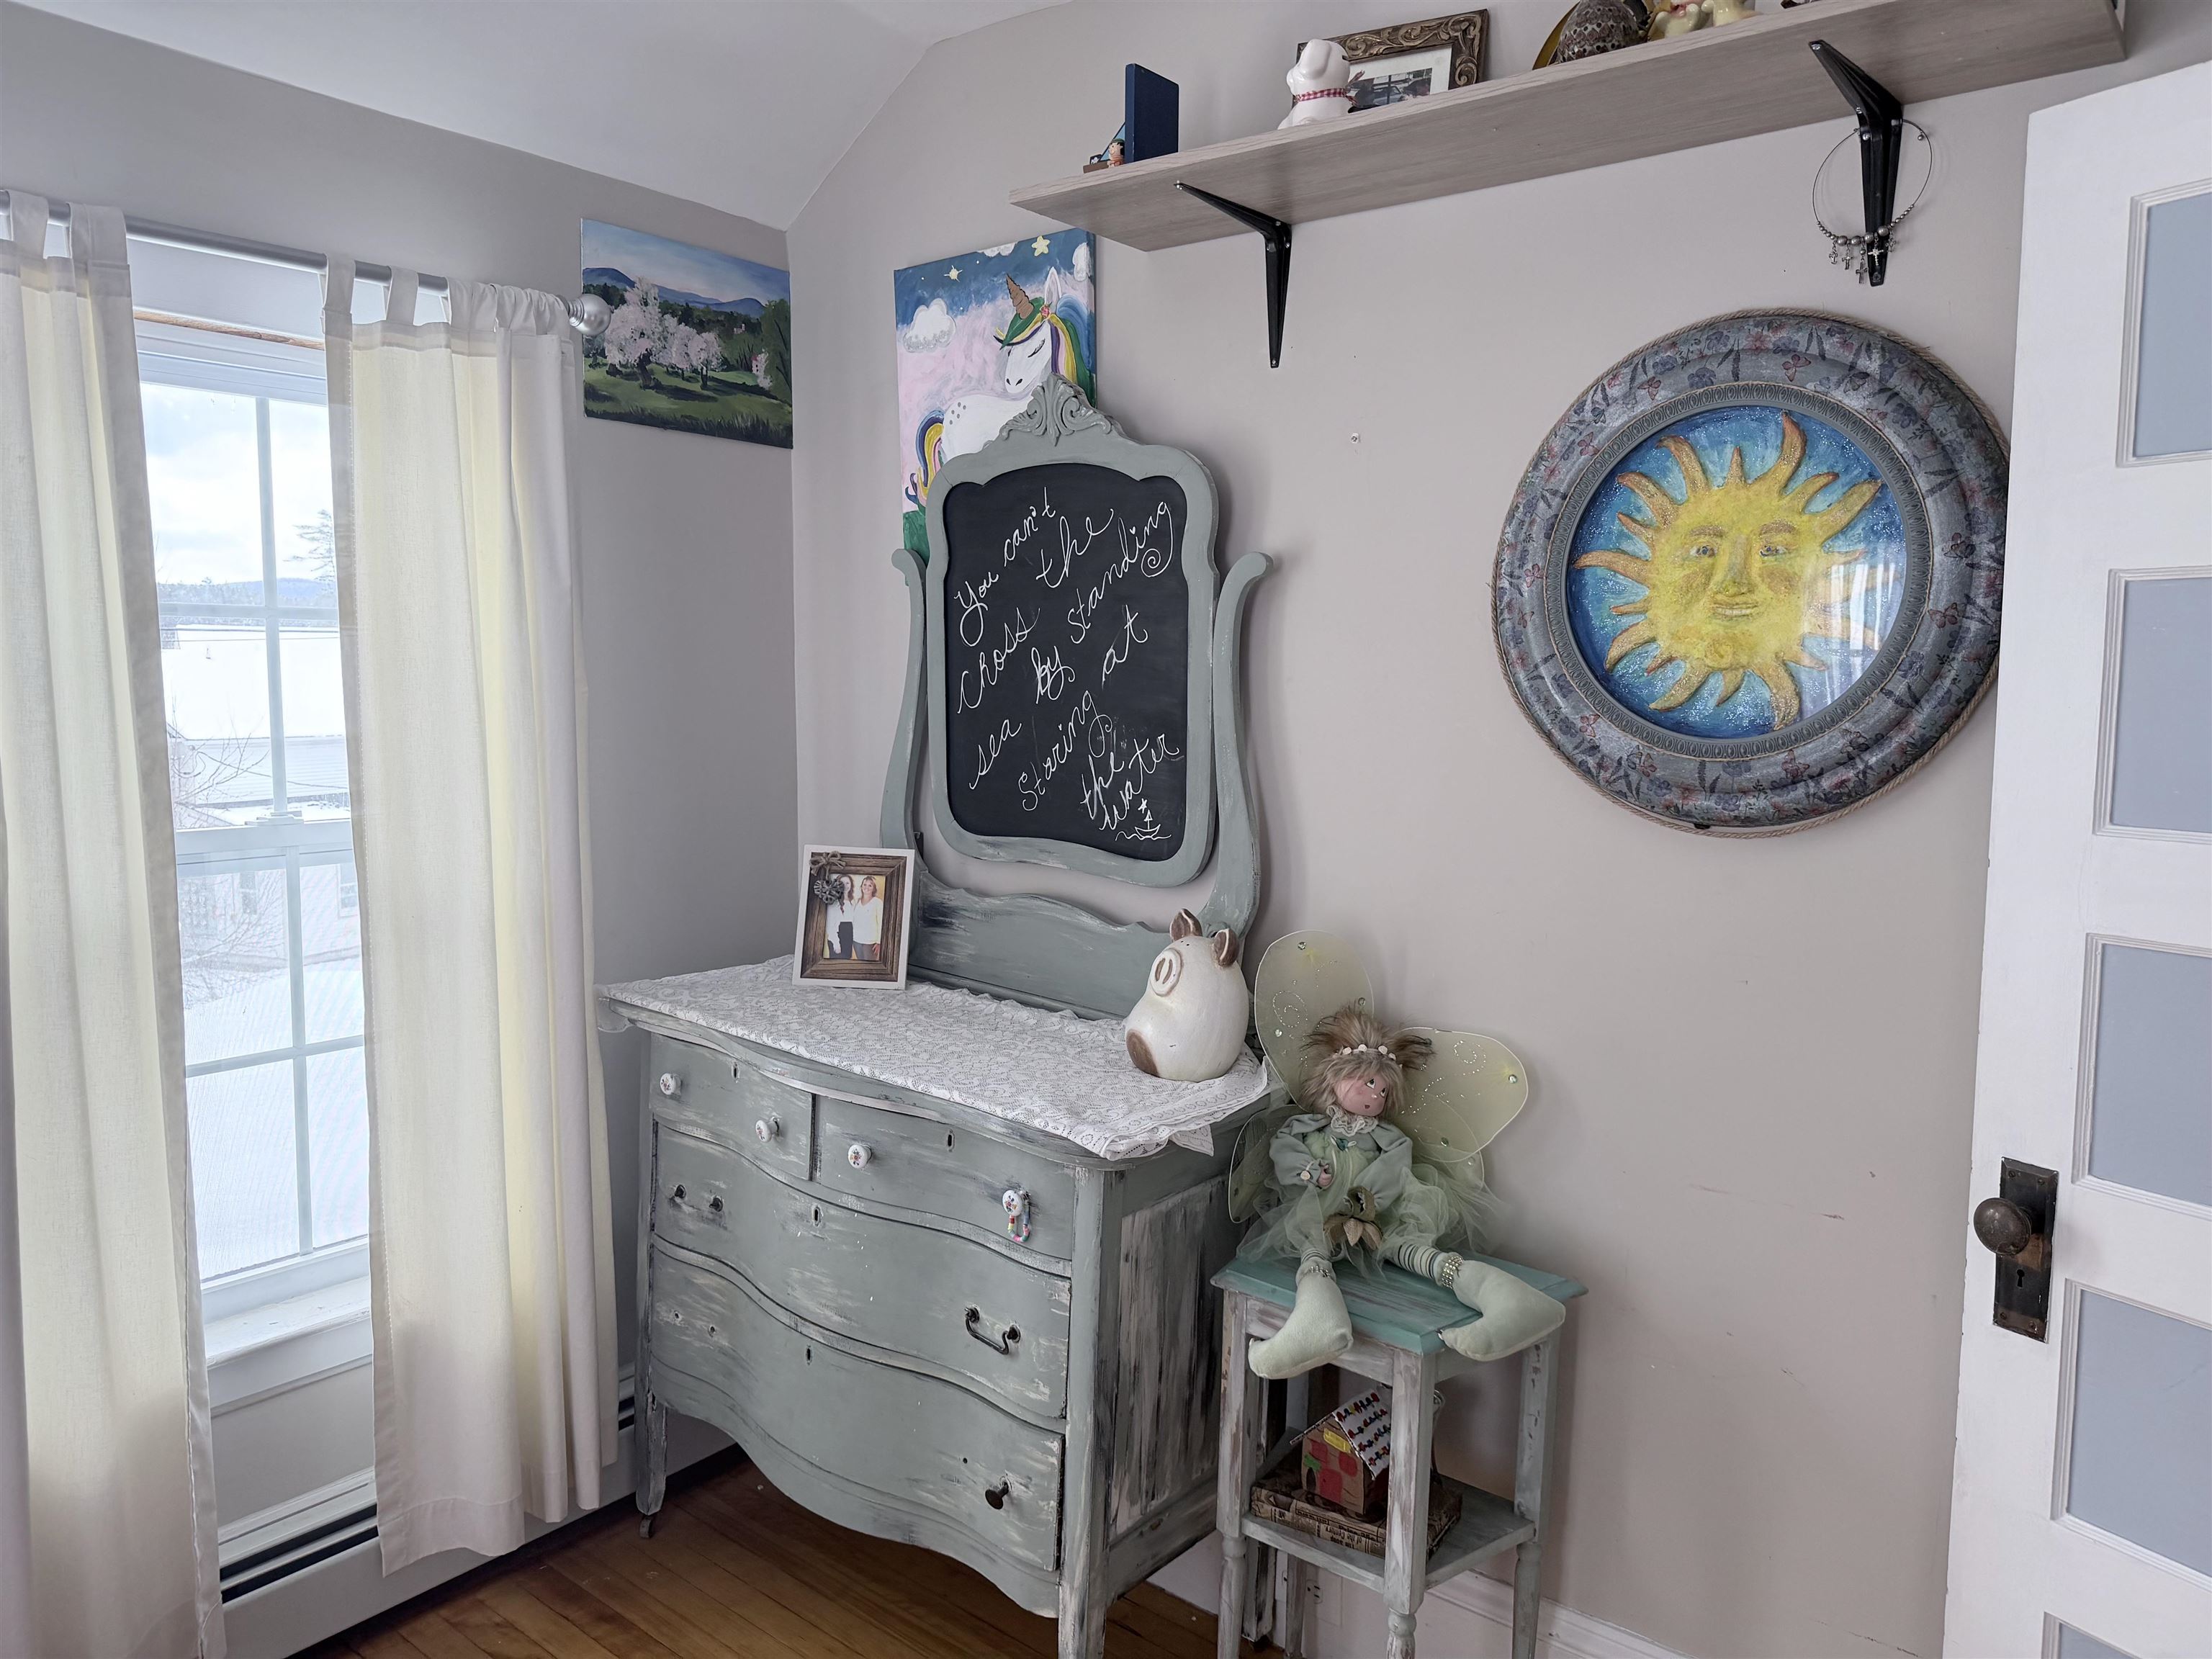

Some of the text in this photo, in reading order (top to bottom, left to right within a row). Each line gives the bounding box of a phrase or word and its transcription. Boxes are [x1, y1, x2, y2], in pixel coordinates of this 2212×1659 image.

[954, 486, 1056, 647] You can't
[1035, 508, 1115, 589] the
[1101, 604, 1148, 690] at
[968, 719, 1022, 790] sea
[1031, 645, 1076, 704] by
[1080, 751, 1125, 819] the
[1099, 733, 1180, 830] water
